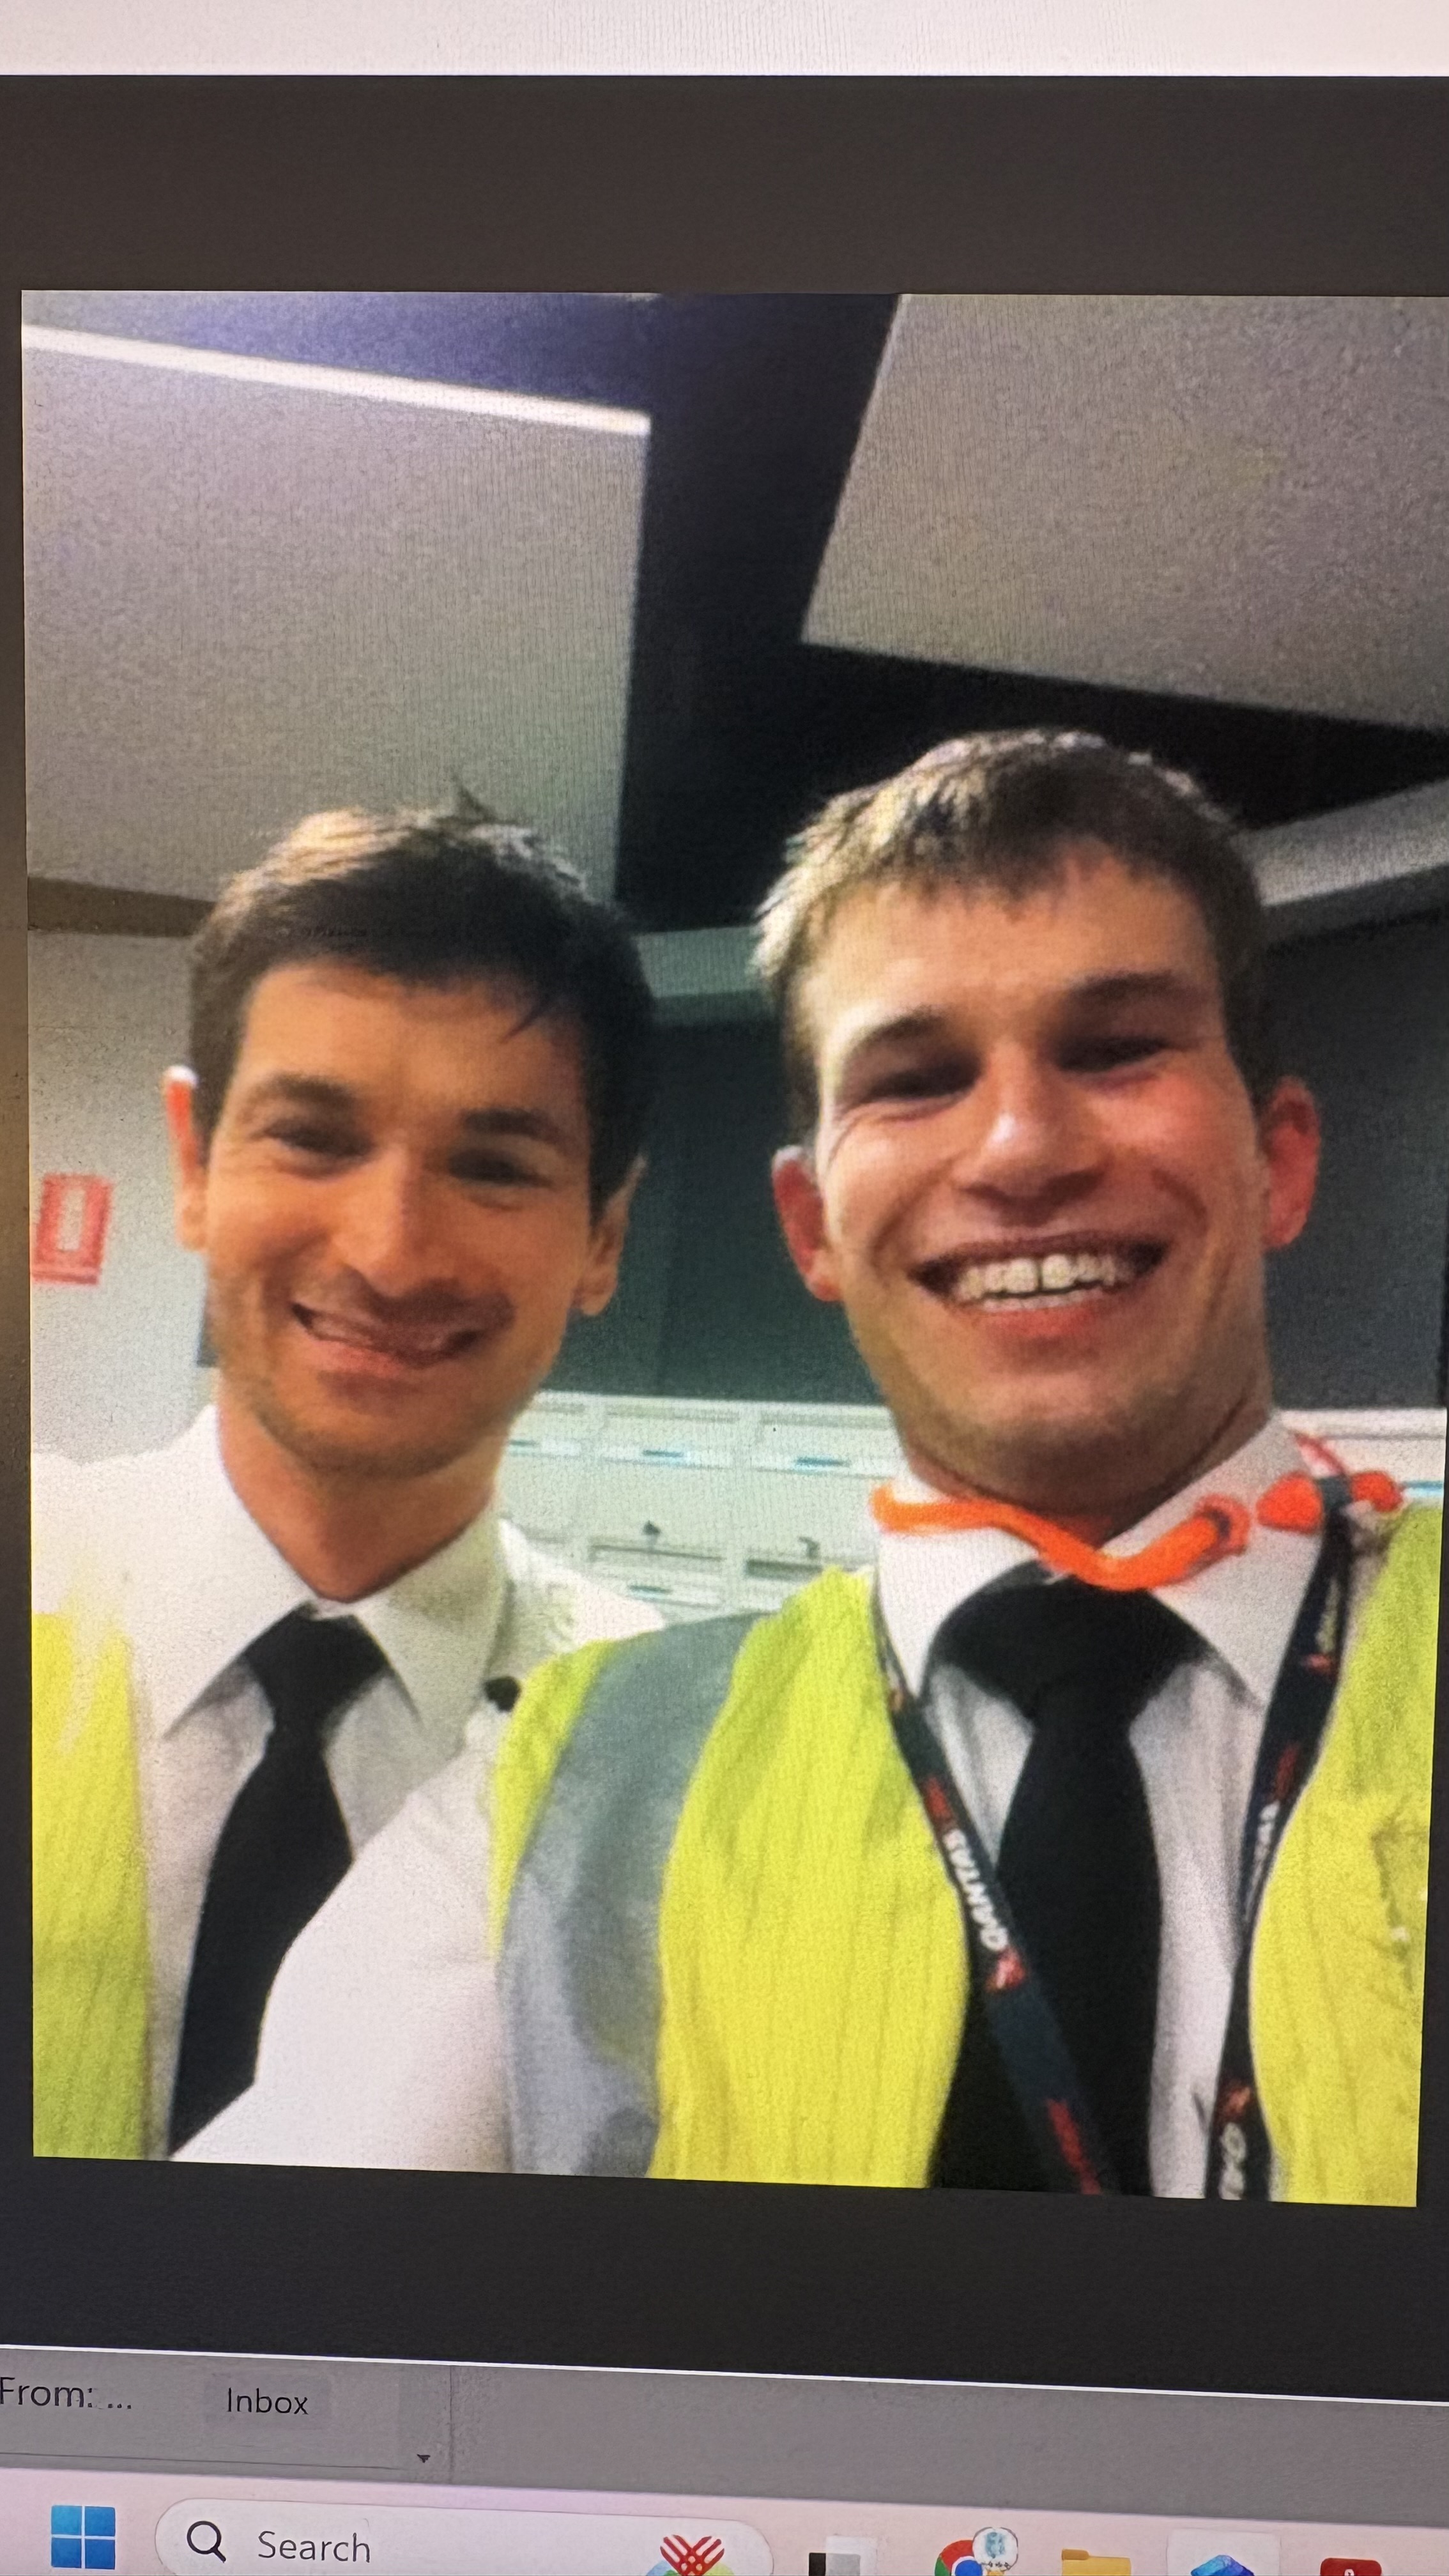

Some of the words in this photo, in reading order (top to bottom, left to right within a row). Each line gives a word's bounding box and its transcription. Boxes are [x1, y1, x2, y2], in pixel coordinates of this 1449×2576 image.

[943, 1828, 1009, 1951] QANTAS
[0, 2376, 94, 2409] From:
[227, 2387, 309, 2416] Inbox
[257, 2530, 372, 2563] Search
